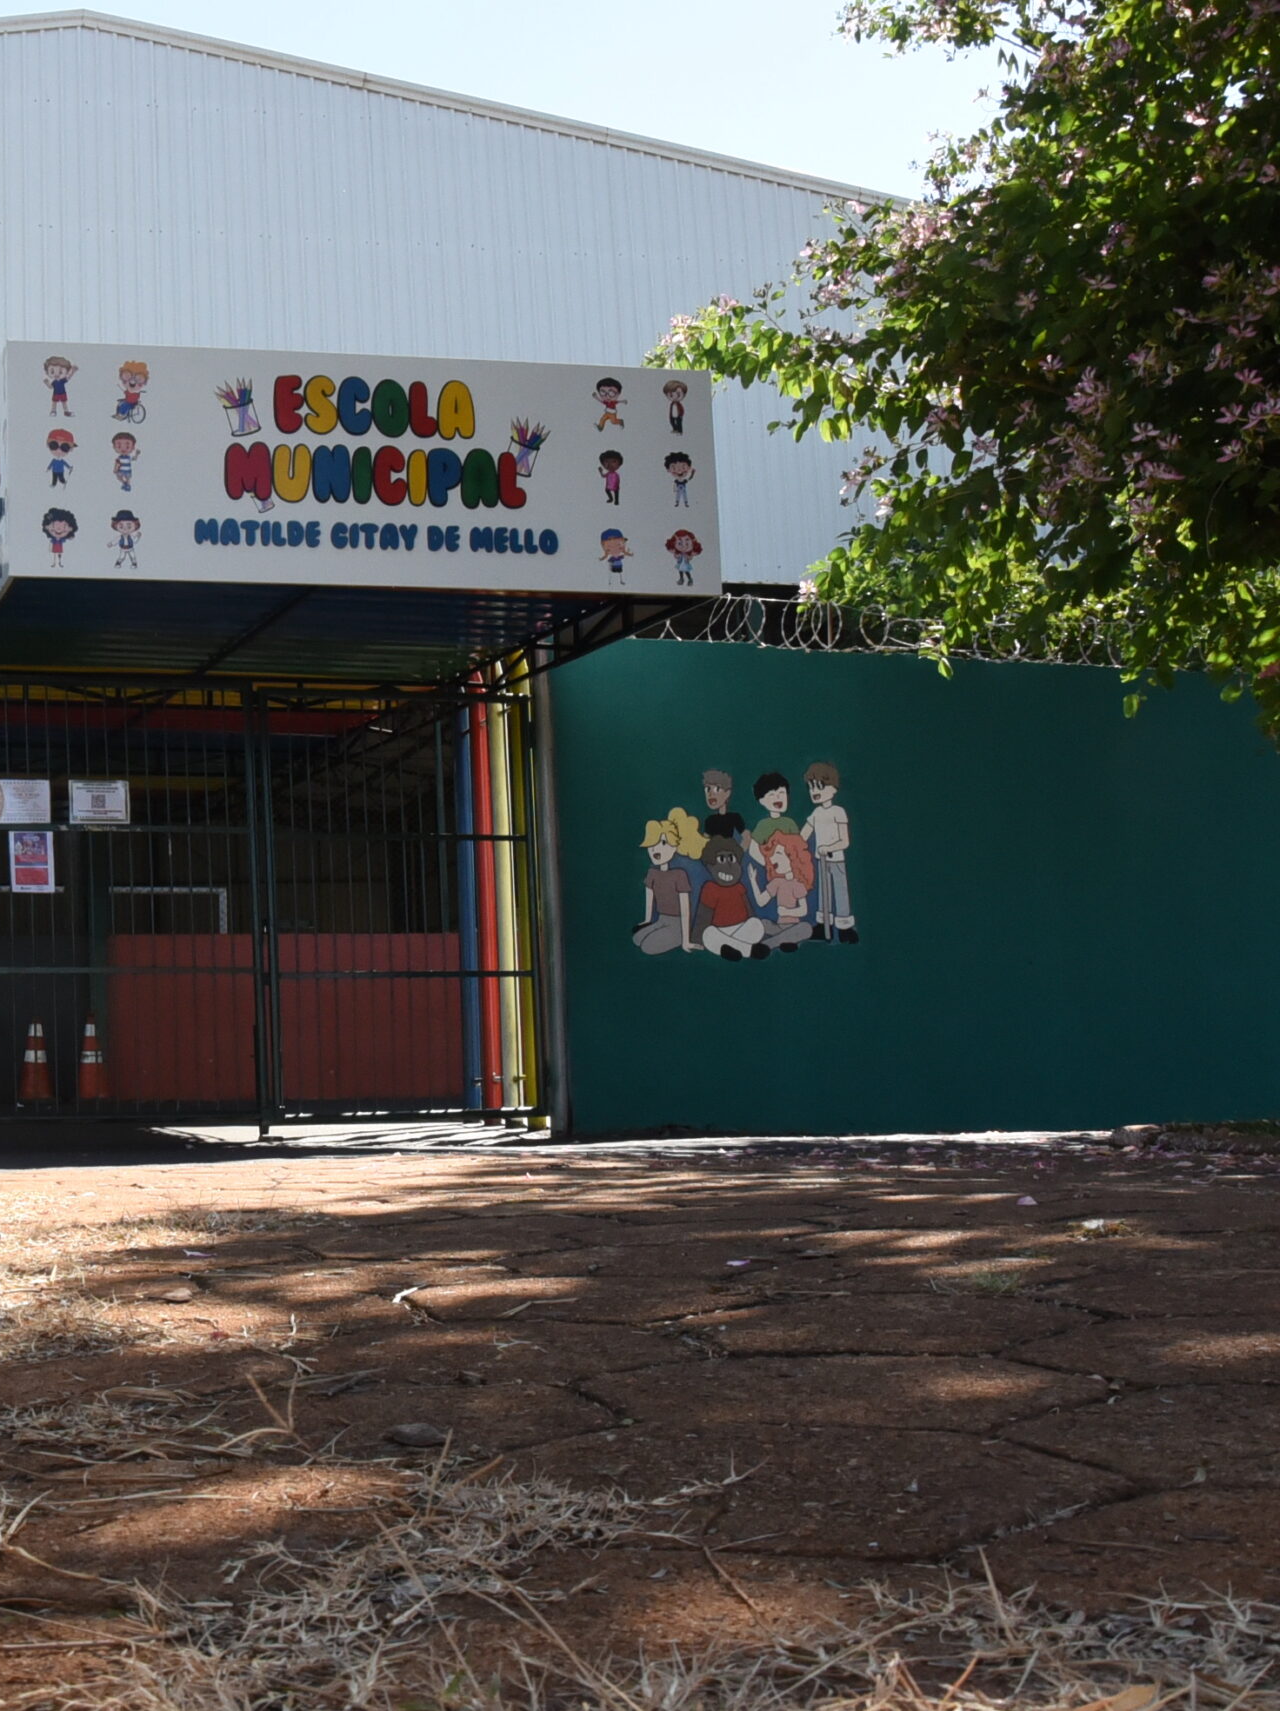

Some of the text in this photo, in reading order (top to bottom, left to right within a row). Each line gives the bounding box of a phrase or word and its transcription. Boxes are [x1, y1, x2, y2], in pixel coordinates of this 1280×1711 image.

[273, 375, 476, 440] ESCOLA
[224, 441, 527, 510] MUNICIPAL
[194, 518, 321, 548] MATILDE
[427, 525, 461, 552] DE
[470, 526, 559, 555] MELLO
